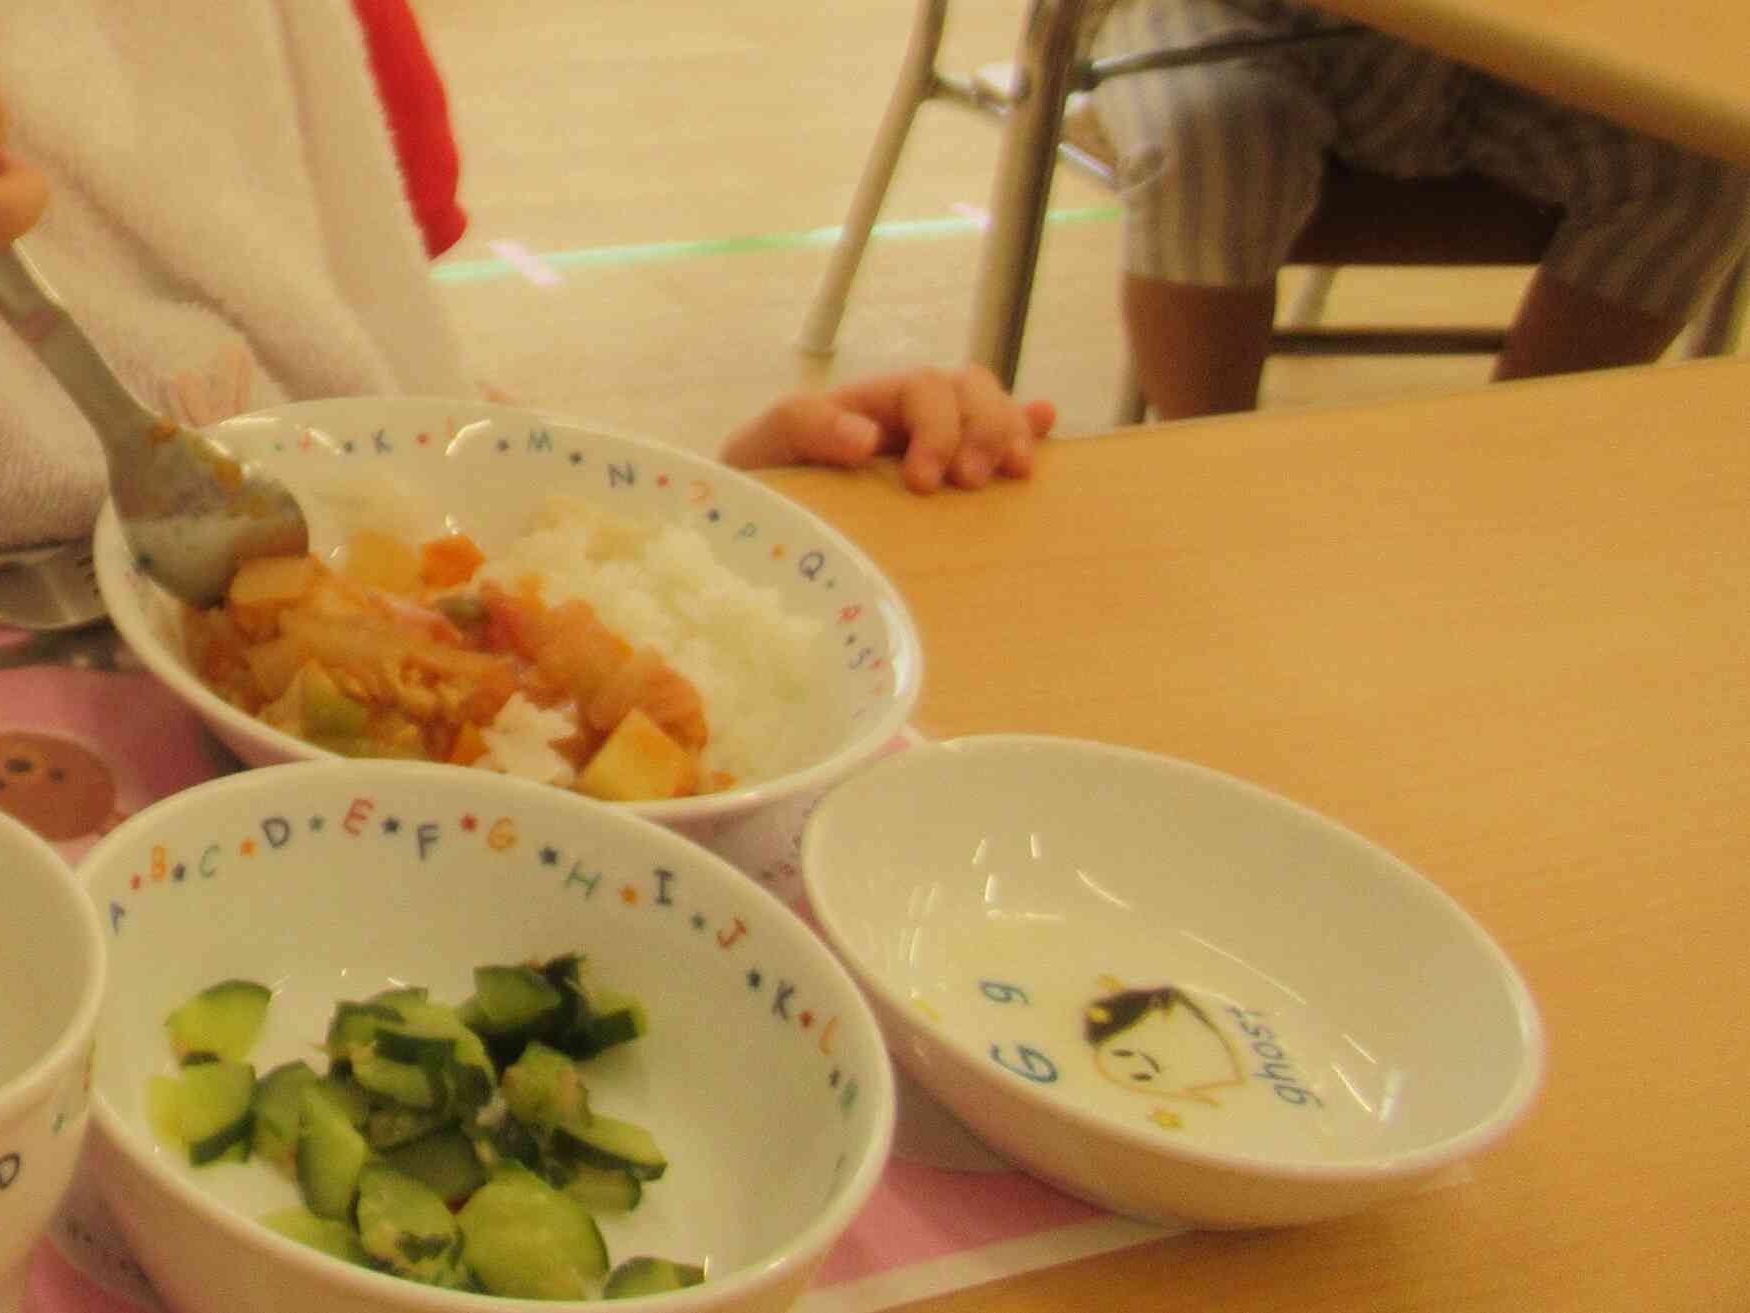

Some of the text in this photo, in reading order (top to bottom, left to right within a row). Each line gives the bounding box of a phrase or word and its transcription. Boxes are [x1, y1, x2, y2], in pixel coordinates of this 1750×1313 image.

[608, 463, 635, 488] N
[799, 552, 825, 580] Q
[199, 844, 221, 880] C
[261, 816, 291, 849] D
[341, 798, 375, 837] E
[415, 822, 440, 862] F
[487, 816, 518, 852] G
[564, 859, 602, 902] H
[653, 868, 674, 907] I
[717, 916, 747, 950] J
[770, 980, 795, 1022] K
